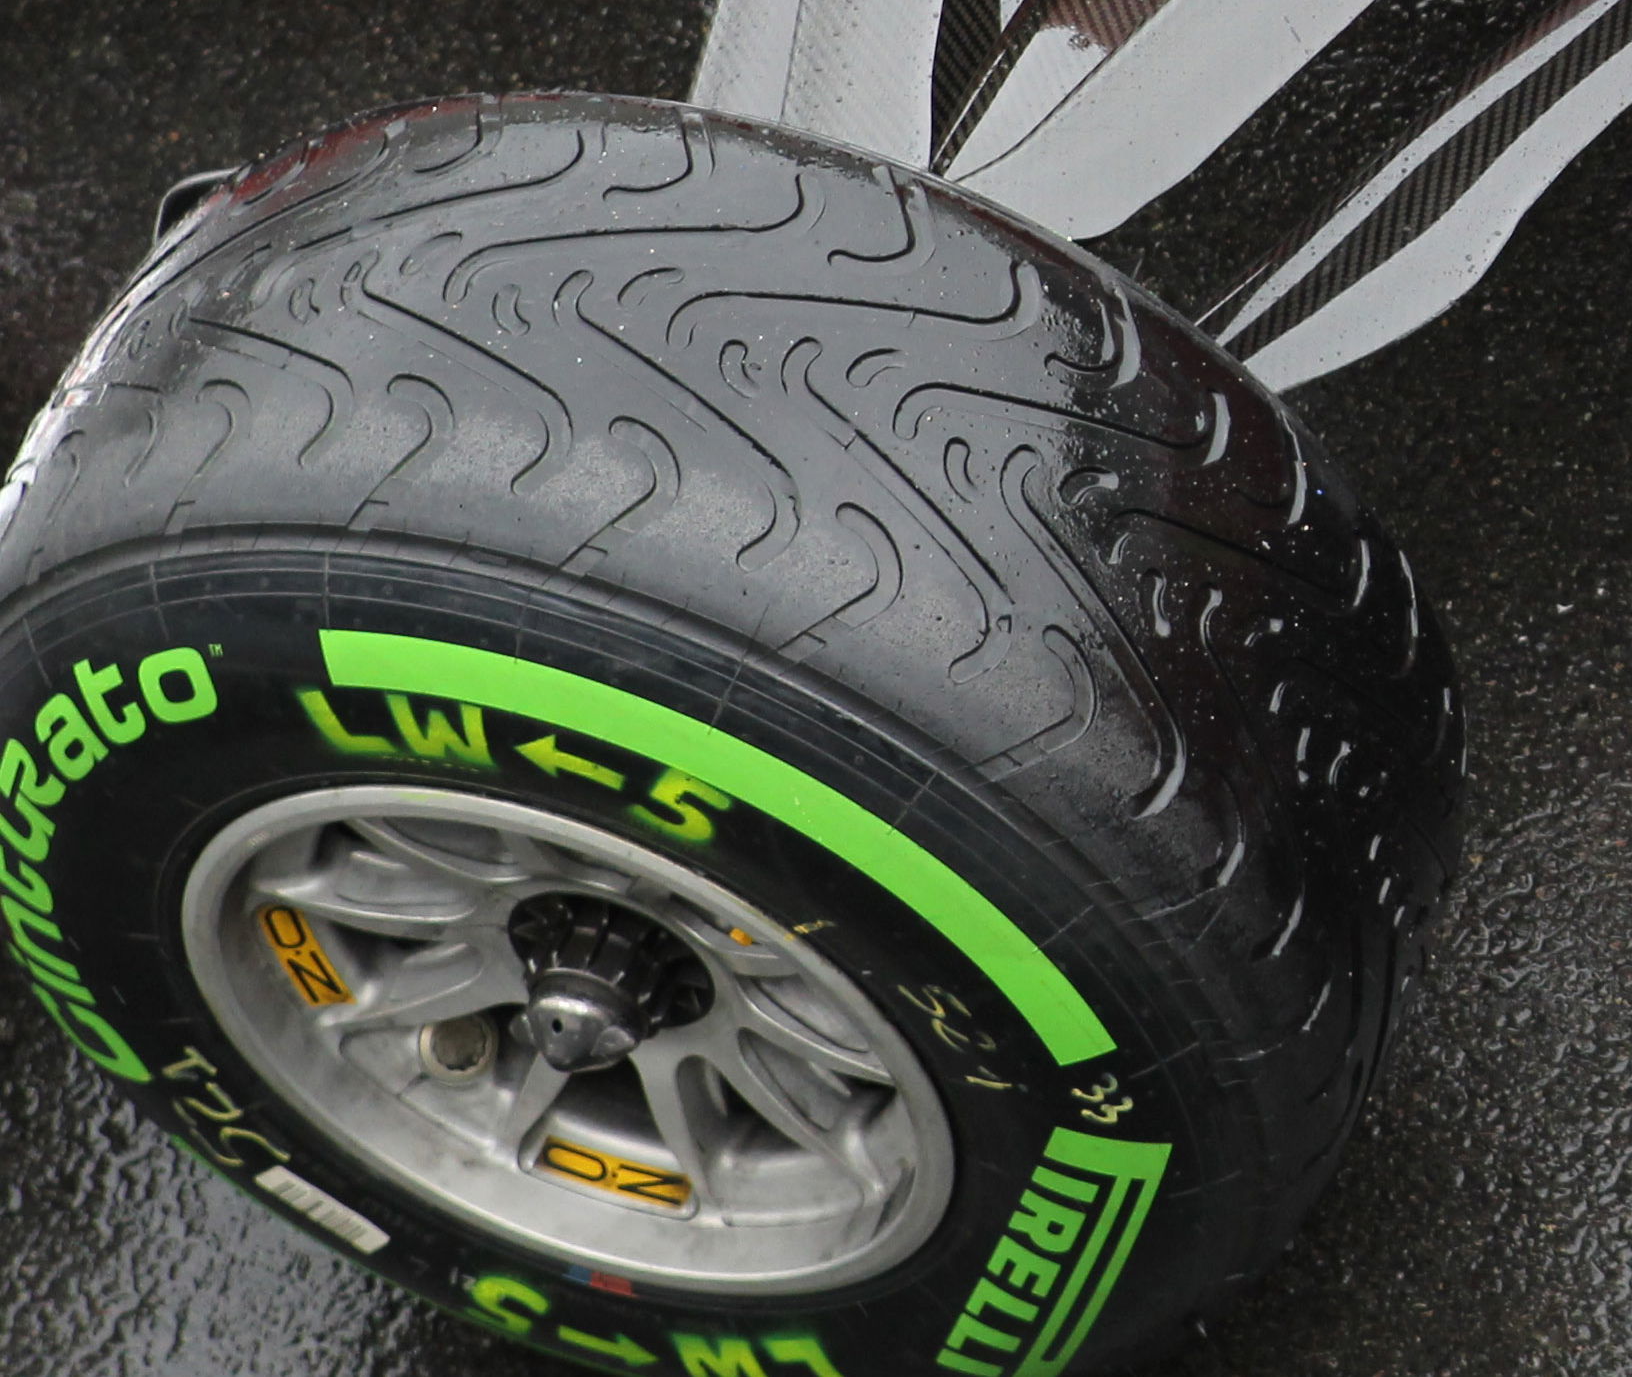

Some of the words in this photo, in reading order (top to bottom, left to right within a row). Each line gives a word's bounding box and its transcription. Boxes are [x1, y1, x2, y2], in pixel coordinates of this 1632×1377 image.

[297, 689, 496, 767] LW
[628, 765, 732, 843] 5
[936, 1126, 1173, 1377] PIRELLI
